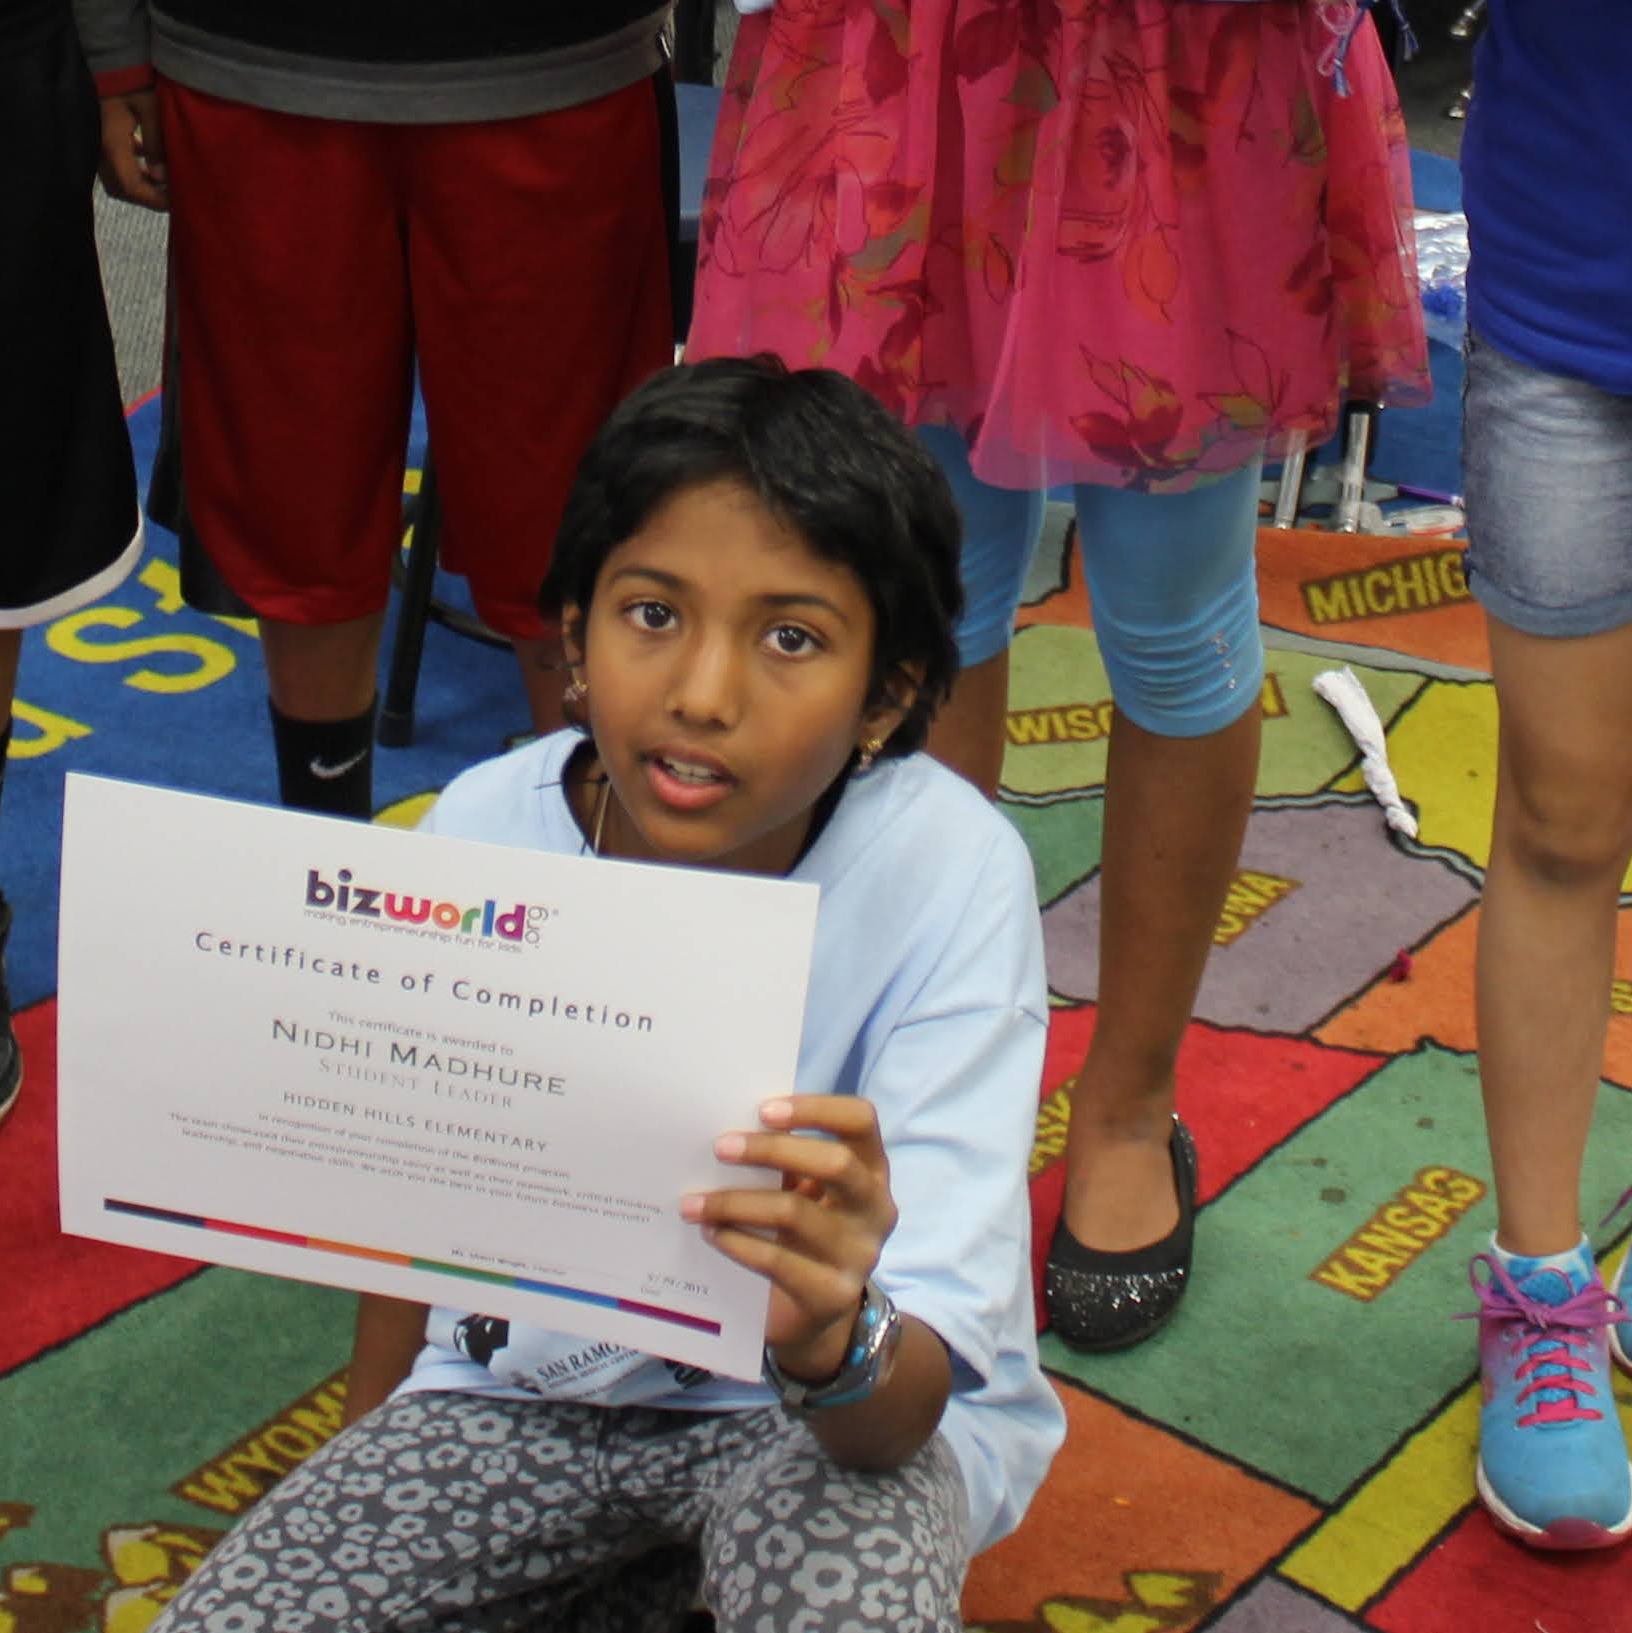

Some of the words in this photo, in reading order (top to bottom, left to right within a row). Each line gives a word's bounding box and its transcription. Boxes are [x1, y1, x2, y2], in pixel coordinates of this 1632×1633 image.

[1306, 553, 1471, 624] MICHIG
[306, 869, 526, 941] bizworld
[196, 932, 379, 984] Certificate
[401, 974, 434, 992] of
[452, 980, 652, 1032] Completion
[273, 1018, 372, 1058] NIDHI
[391, 1041, 565, 1101] MADHURE
[284, 1091, 354, 1116] HIDDEN
[364, 1107, 415, 1128] HILLS
[421, 1120, 547, 1156] ELEMENTARY
[1316, 1168, 1483, 1296] KANSAS
